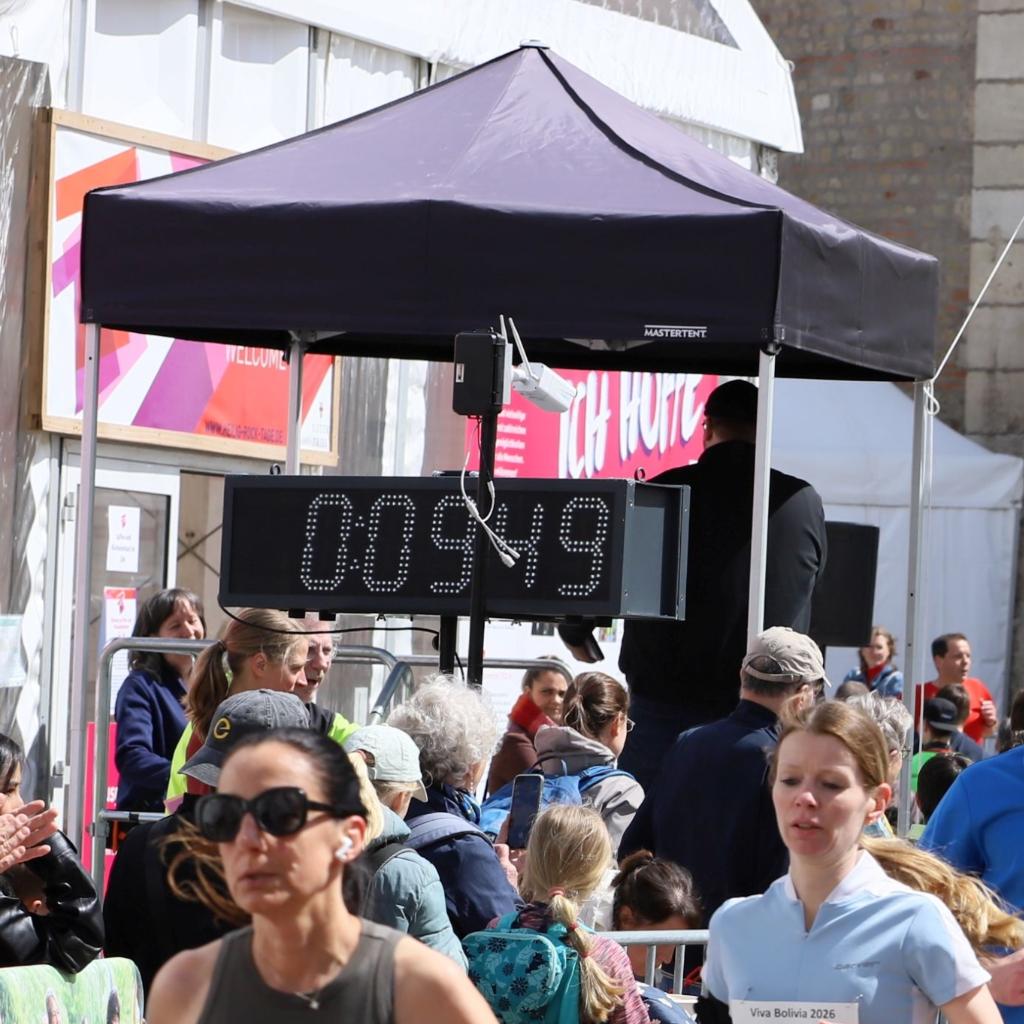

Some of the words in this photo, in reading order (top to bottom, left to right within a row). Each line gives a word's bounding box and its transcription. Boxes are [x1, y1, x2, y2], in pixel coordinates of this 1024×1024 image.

[644, 328, 707, 338] MASTERTENT
[558, 371, 612, 479] ICH
[750, 1007, 771, 1018] Viva
[774, 1008, 808, 1019] Bolivia
[810, 1008, 836, 1019] 2026
